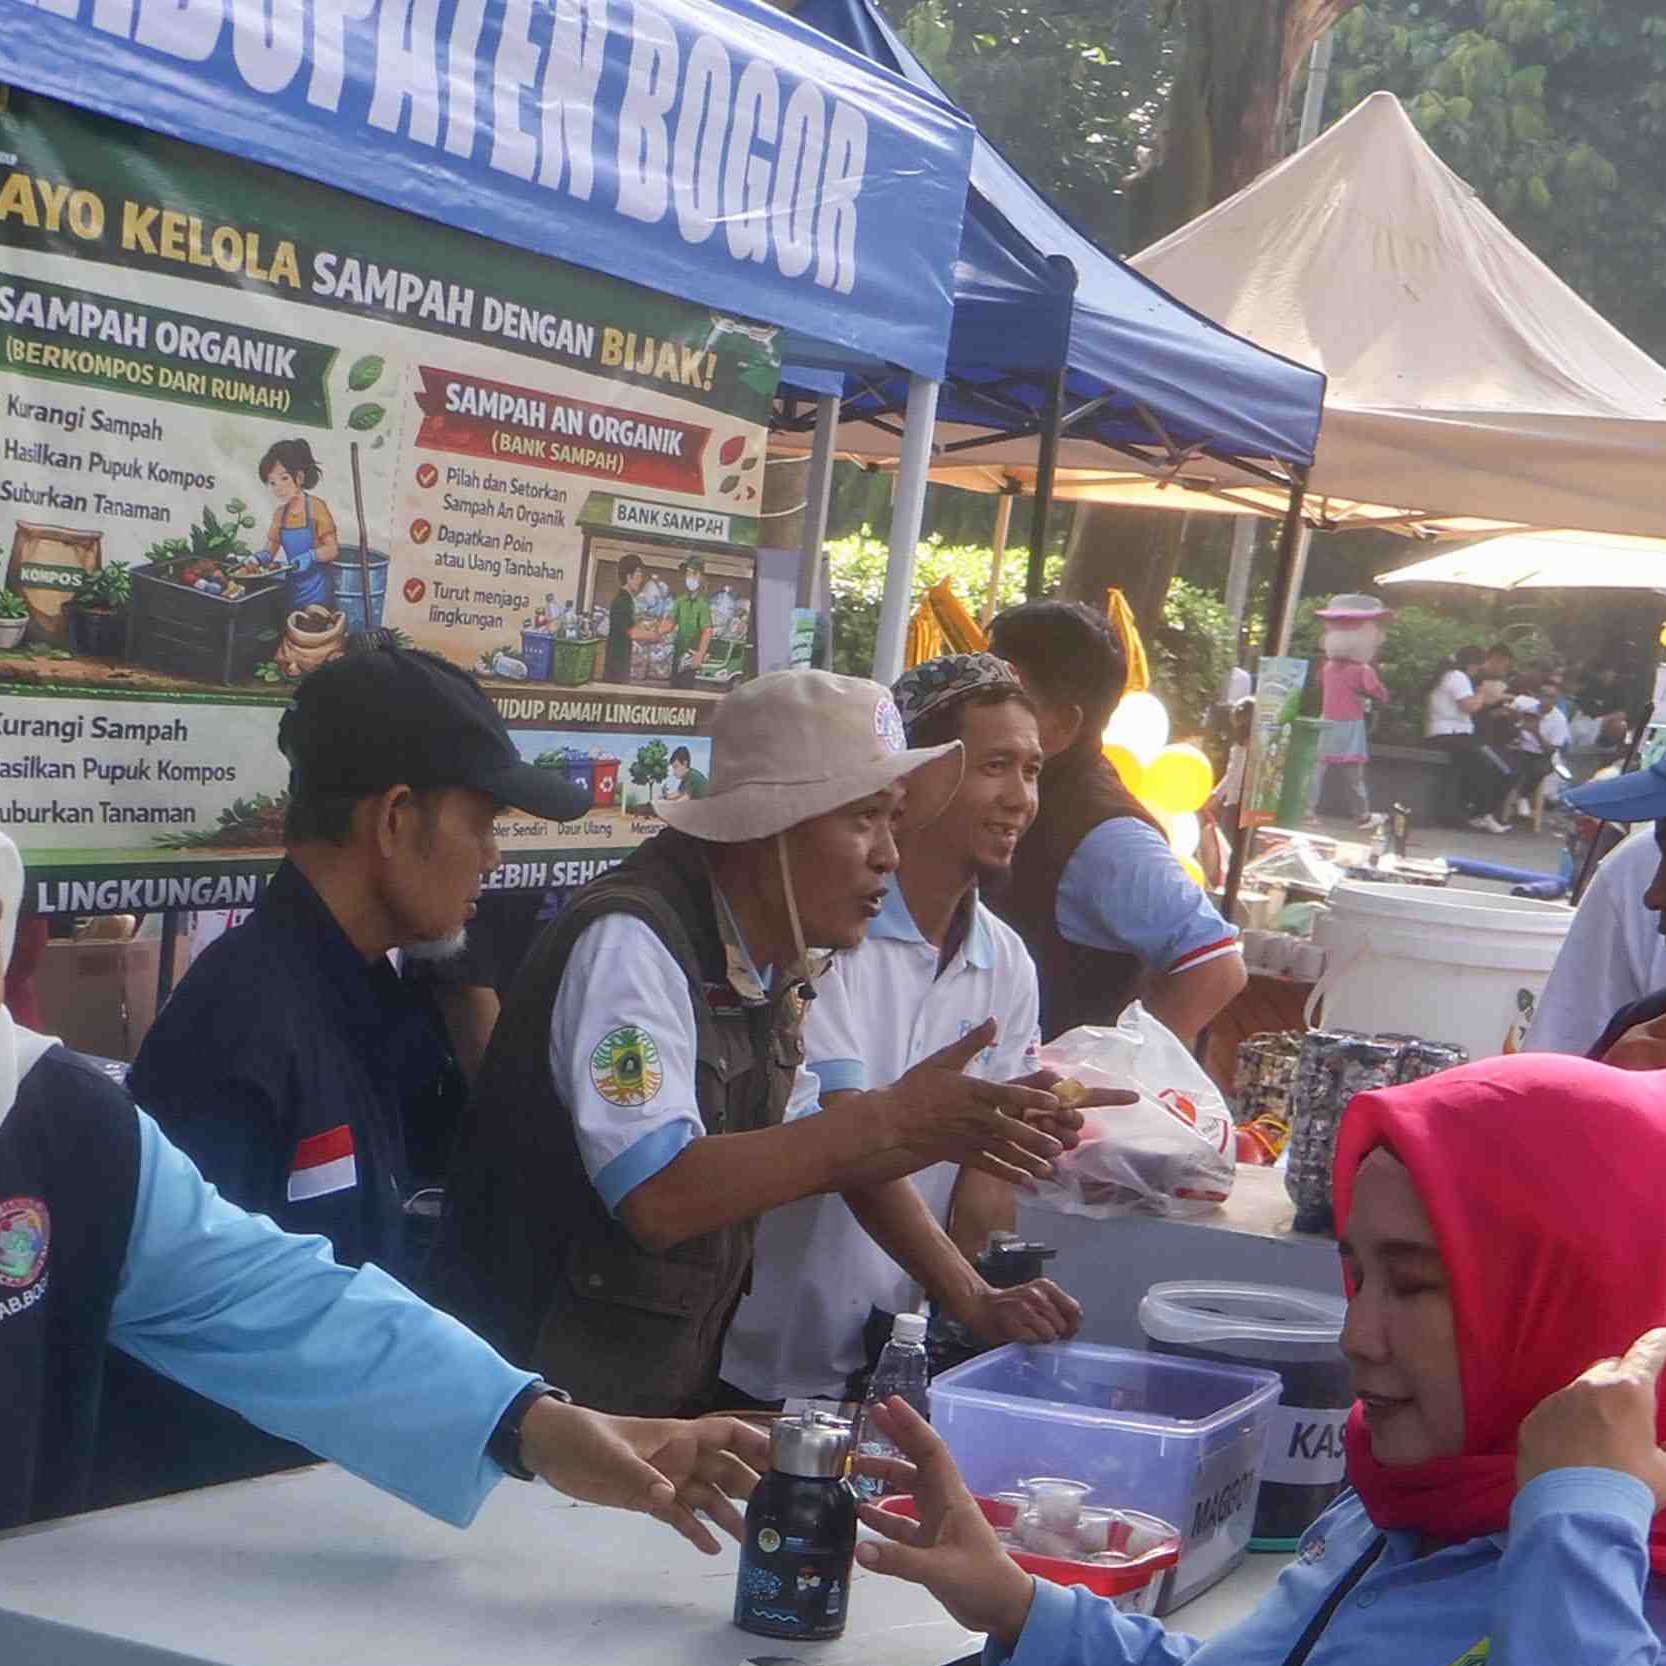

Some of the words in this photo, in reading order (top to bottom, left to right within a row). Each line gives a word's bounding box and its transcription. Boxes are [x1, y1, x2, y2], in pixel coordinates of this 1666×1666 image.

[617, 5, 867, 295] BOGOR
[120, 202, 301, 289] KELOLA
[311, 251, 475, 328] SAMPAH
[481, 296, 595, 358] DENGAN
[600, 326, 718, 392] BIJAK!
[155, 322, 297, 379] ORGANIK
[5, 335, 154, 386] (BERKOMPOS
[157, 366, 207, 395] DARI
[211, 376, 292, 413] RUMAH)
[7, 394, 85, 432] Kurangi
[90, 409, 163, 442] Sampah
[445, 383, 546, 431] SAMPAH
[551, 409, 583, 436] AN
[588, 413, 683, 457] ORGANIK
[4, 438, 82, 471] Hasilkan
[88, 451, 143, 479] Pupuk
[147, 461, 216, 491] Kompos
[492, 430, 546, 459] (BANK
[550, 441, 624, 475] SAMPAH)
[446, 466, 480, 489] Pilah
[483, 473, 508, 494] dan
[510, 478, 568, 503] Setorkan
[0, 480, 87, 514] Suburkan
[93, 492, 171, 523] Tanaman
[443, 494, 495, 521] Sampah
[497, 503, 515, 519] An
[516, 506, 566, 530] Organik
[617, 504, 660, 527] BANK
[662, 511, 723, 535] SAMPAH
[437, 524, 501, 552] Dapatkan
[504, 533, 534, 553] Poin
[20, 566, 82, 588] KOMPOS
[434, 551, 464, 569] atau
[468, 550, 502, 577] Uang
[433, 581, 470, 601] Turut
[473, 590, 530, 611] menjaga
[429, 605, 503, 630] lingkungan
[548, 700, 602, 723] RAMAH
[604, 704, 697, 727] LINGKUNGAN
[90, 716, 189, 745] Sampah
[83, 758, 151, 786] Pupuk
[157, 760, 237, 787] Kompos
[100, 802, 196, 825] Tanaman
[510, 820, 548, 837] Sendiri
[557, 821, 581, 835] Daur
[551, 859, 622, 887] SEHA
[36, 873, 257, 915] LINGKUNGAN
